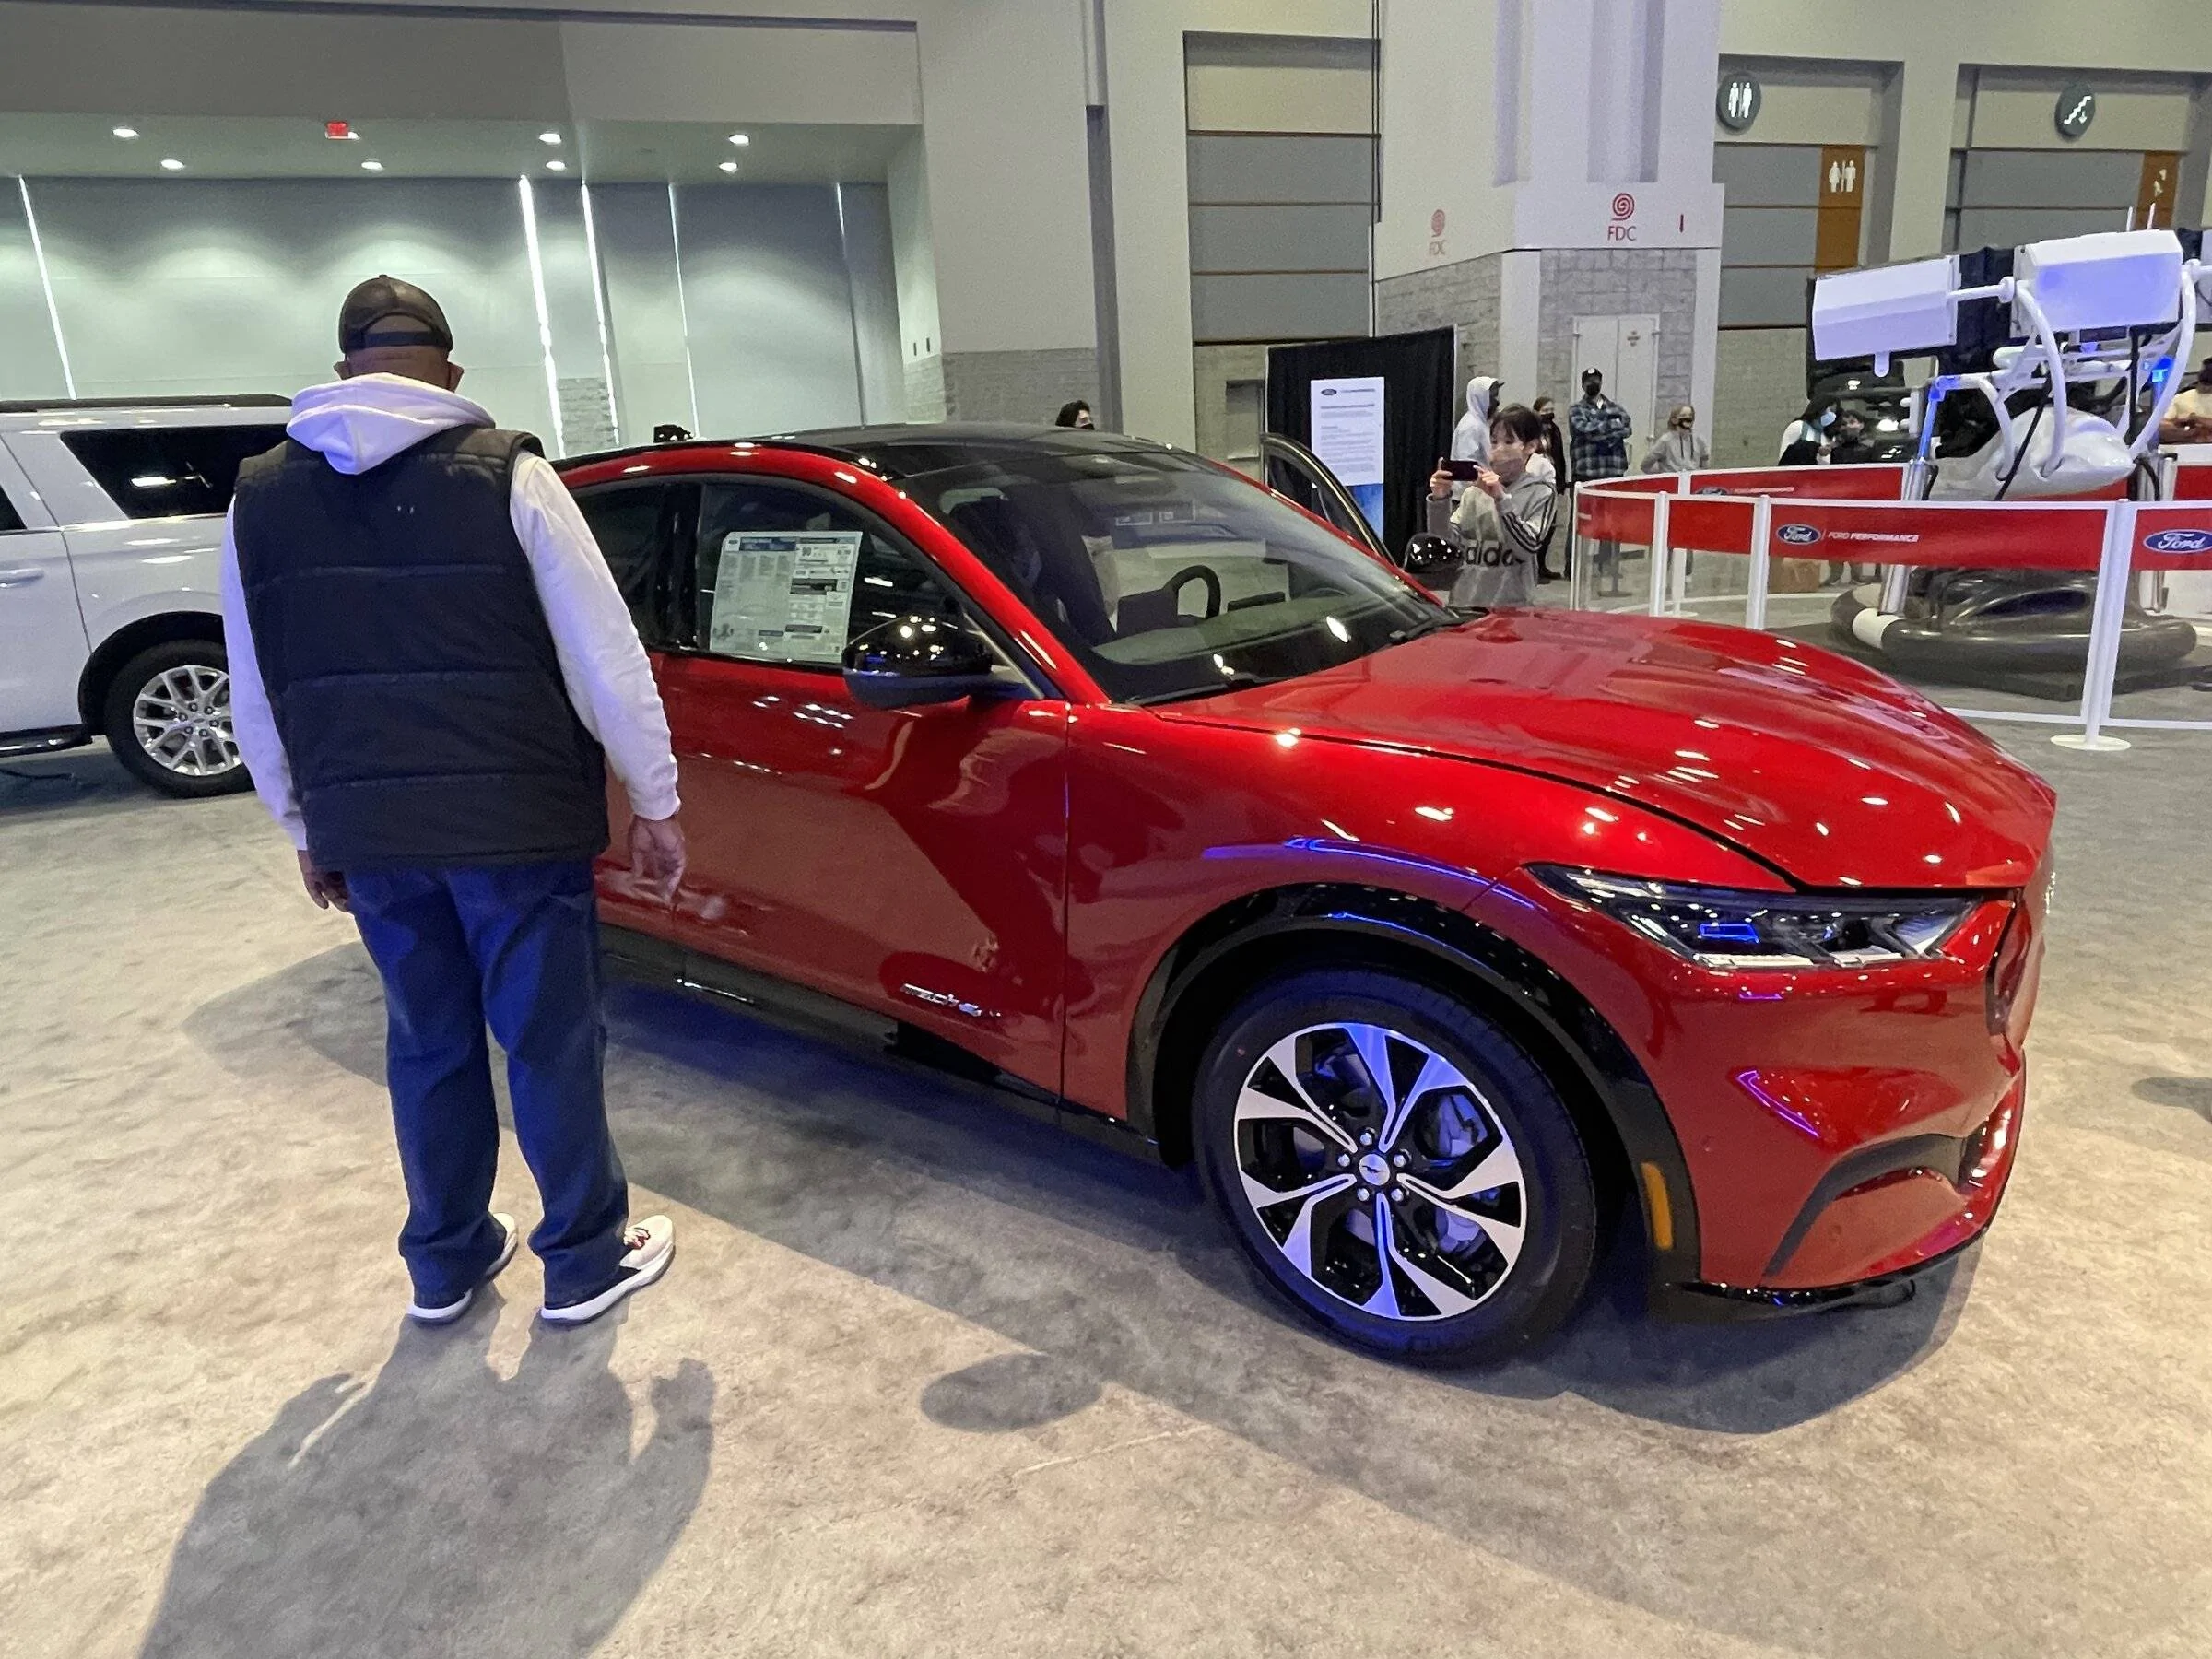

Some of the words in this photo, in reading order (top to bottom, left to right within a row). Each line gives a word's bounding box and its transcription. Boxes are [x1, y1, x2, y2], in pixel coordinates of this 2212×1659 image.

[1607, 225, 1637, 241] FDC
[1783, 526, 1812, 542] Ford
[1828, 531, 1850, 540] FORD
[1850, 533, 1920, 542] PERFORMANCE
[2158, 533, 2206, 549] Ford
